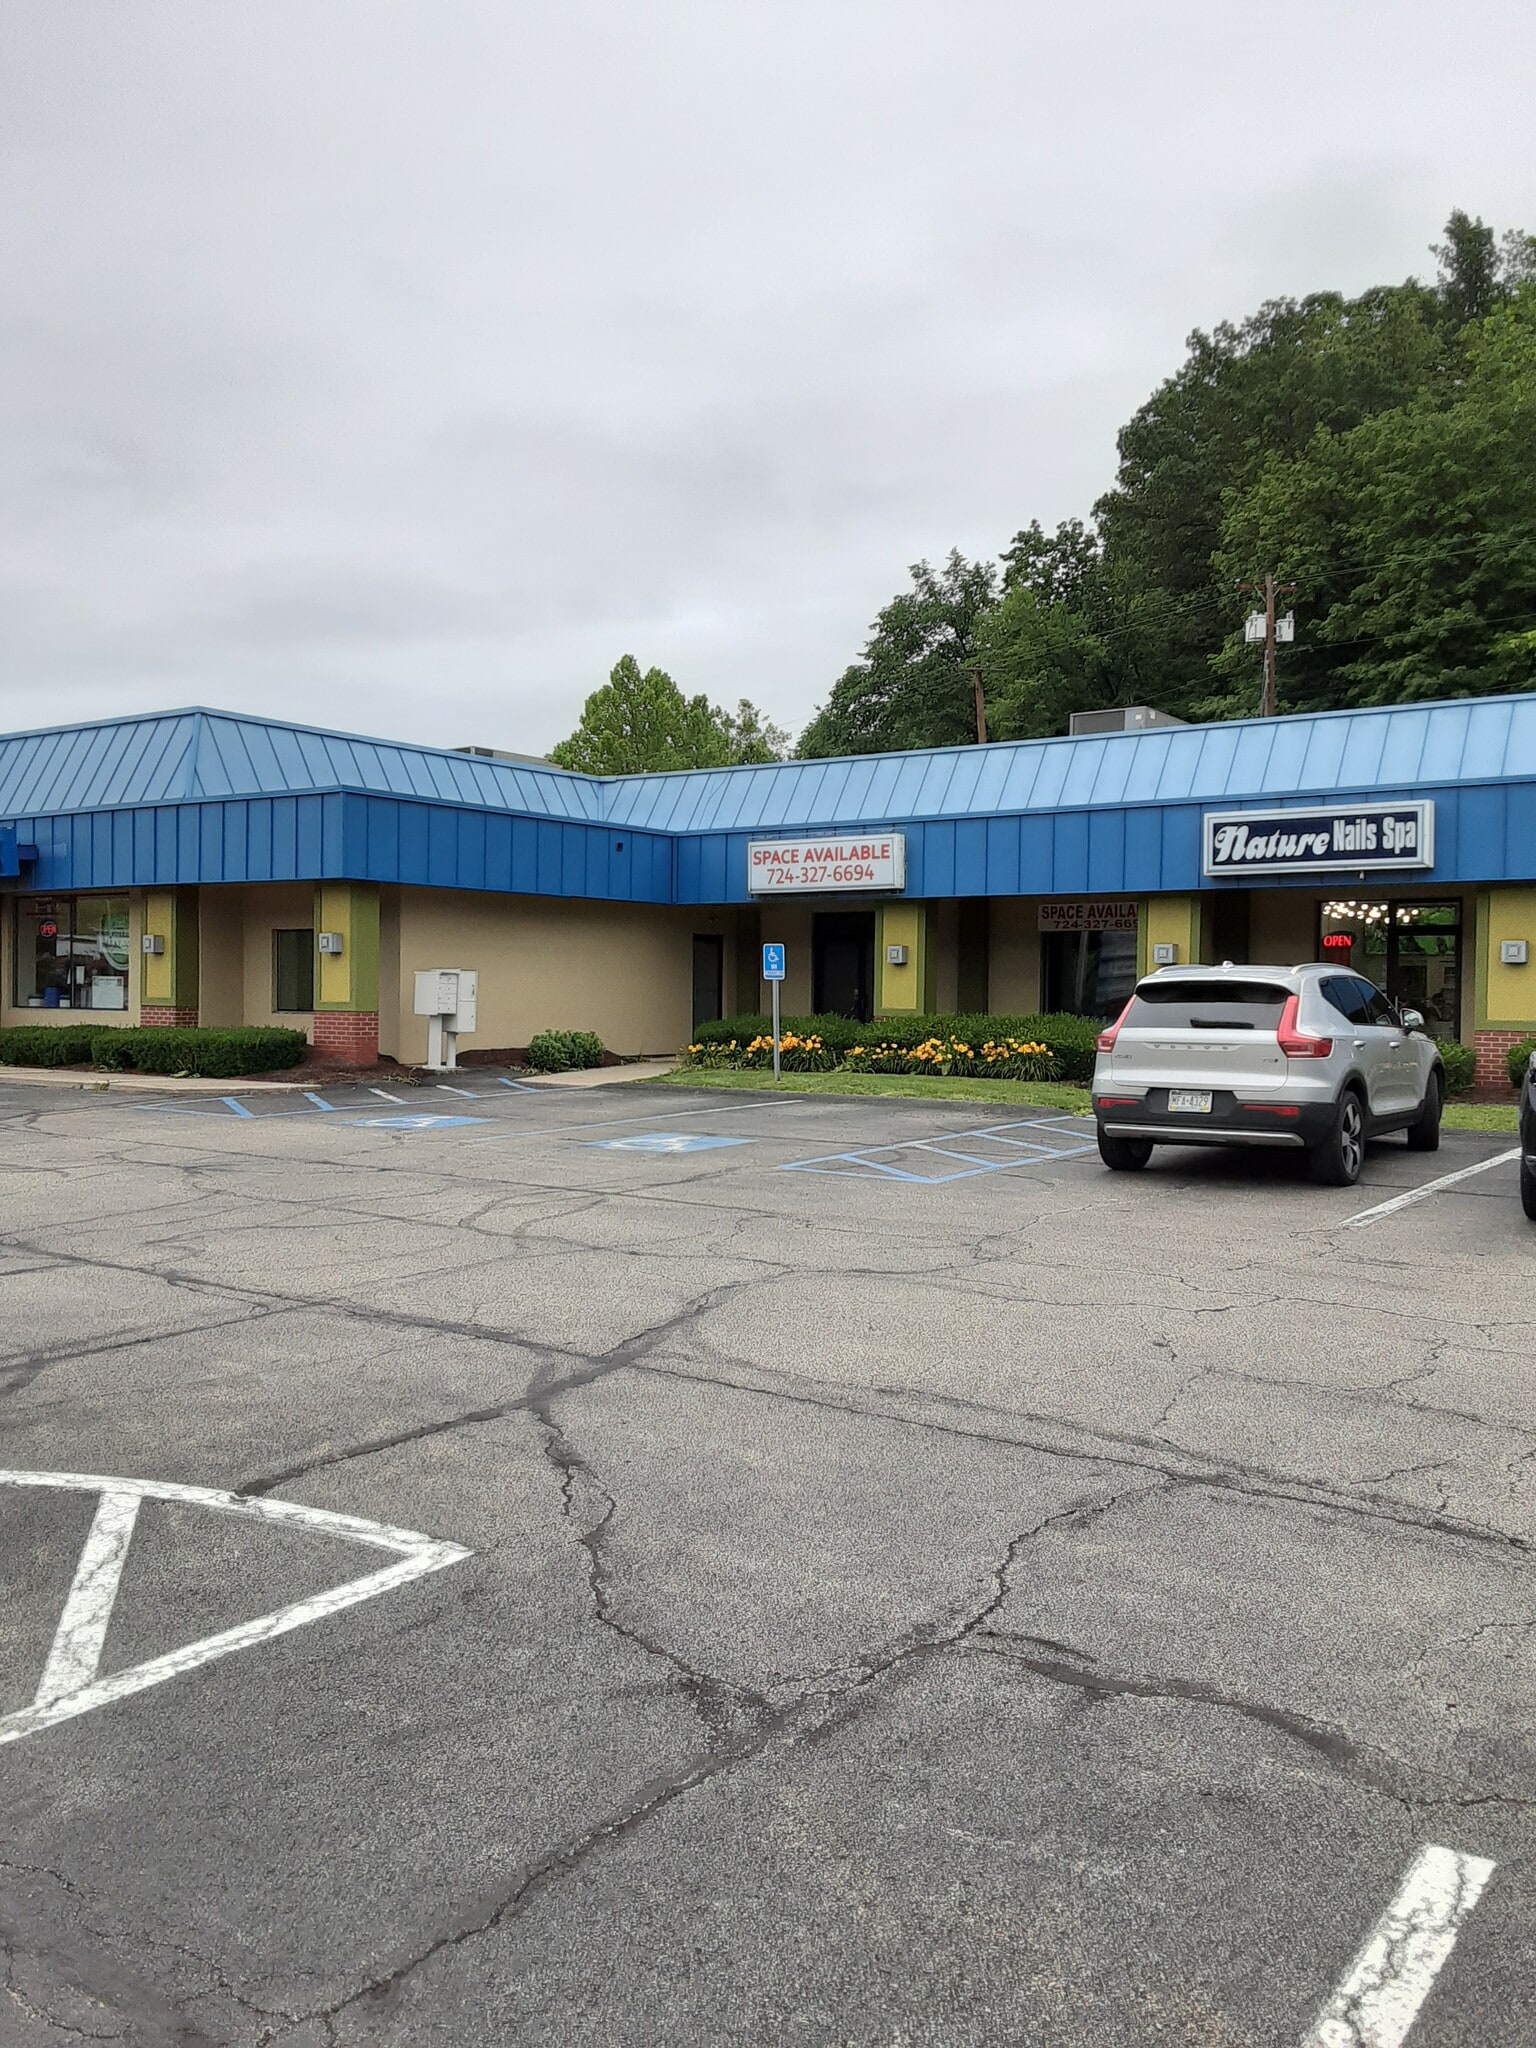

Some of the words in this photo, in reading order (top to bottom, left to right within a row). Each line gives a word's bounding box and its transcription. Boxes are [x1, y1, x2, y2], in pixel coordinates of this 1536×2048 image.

[1215, 826, 1329, 862] Nature
[1333, 819, 1376, 851] Nails
[1382, 817, 1416, 854] Spa
[753, 849, 799, 866] SPACE
[804, 844, 890, 863] AVAILABLE
[767, 864, 875, 885] 724-327-6694
[1042, 906, 1083, 919] SPACE
[1087, 904, 1137, 919] AVAILA
[40, 924, 57, 934] OPEN
[1054, 920, 1138, 929] 724-327-669
[1323, 935, 1352, 947] OPEN
